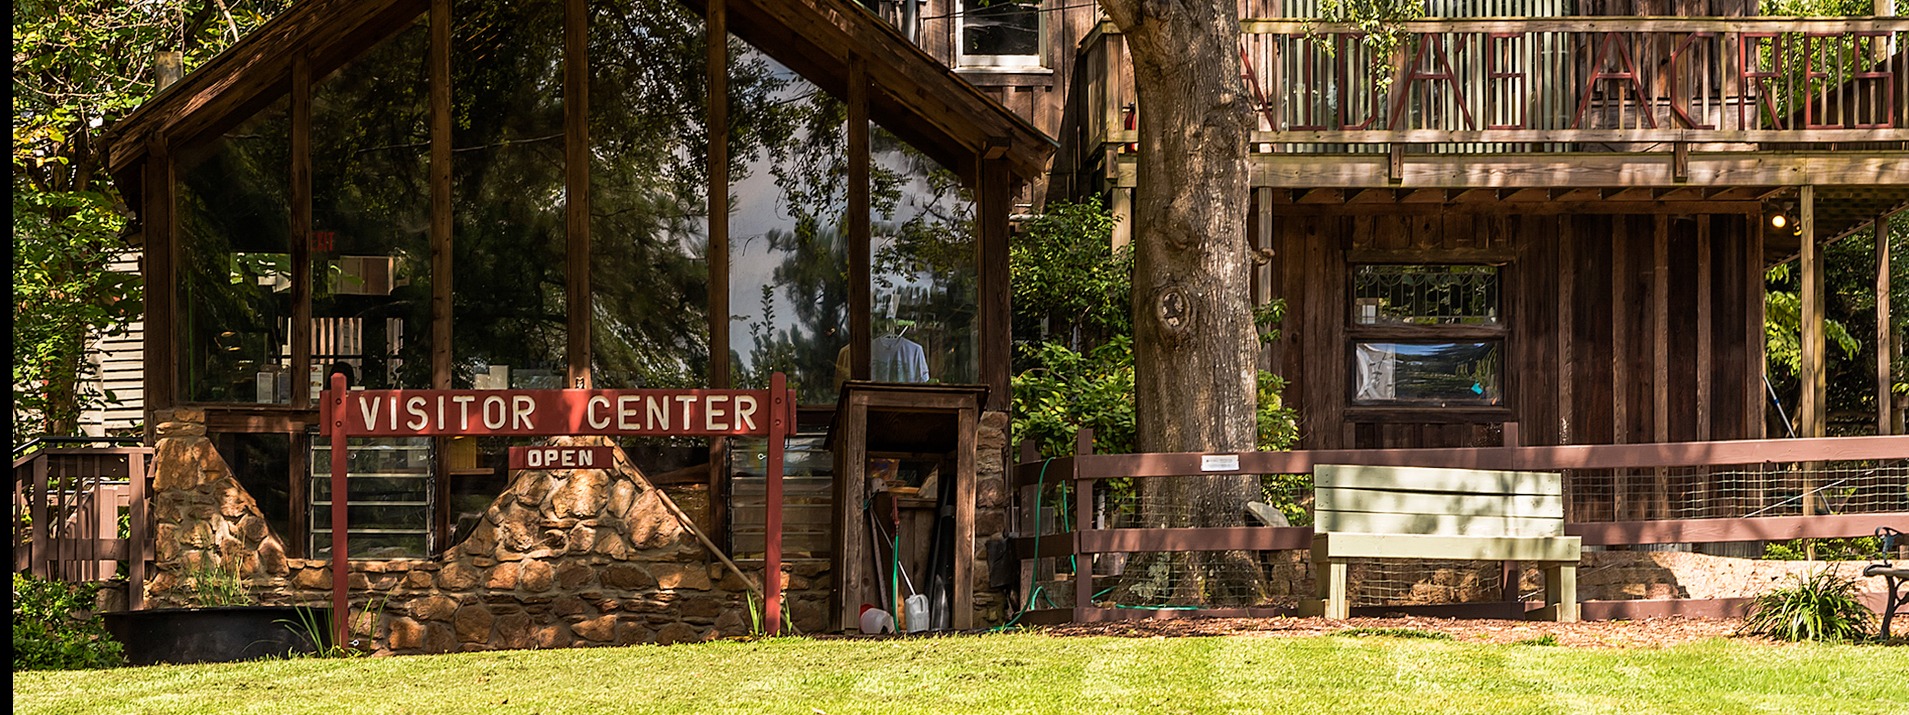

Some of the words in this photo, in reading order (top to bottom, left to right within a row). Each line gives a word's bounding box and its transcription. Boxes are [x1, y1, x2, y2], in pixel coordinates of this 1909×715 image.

[1571, 32, 1894, 130] ACRES
[359, 395, 536, 431] VISITOR
[588, 395, 758, 431] CENTER
[527, 449, 594, 467] OPEN
